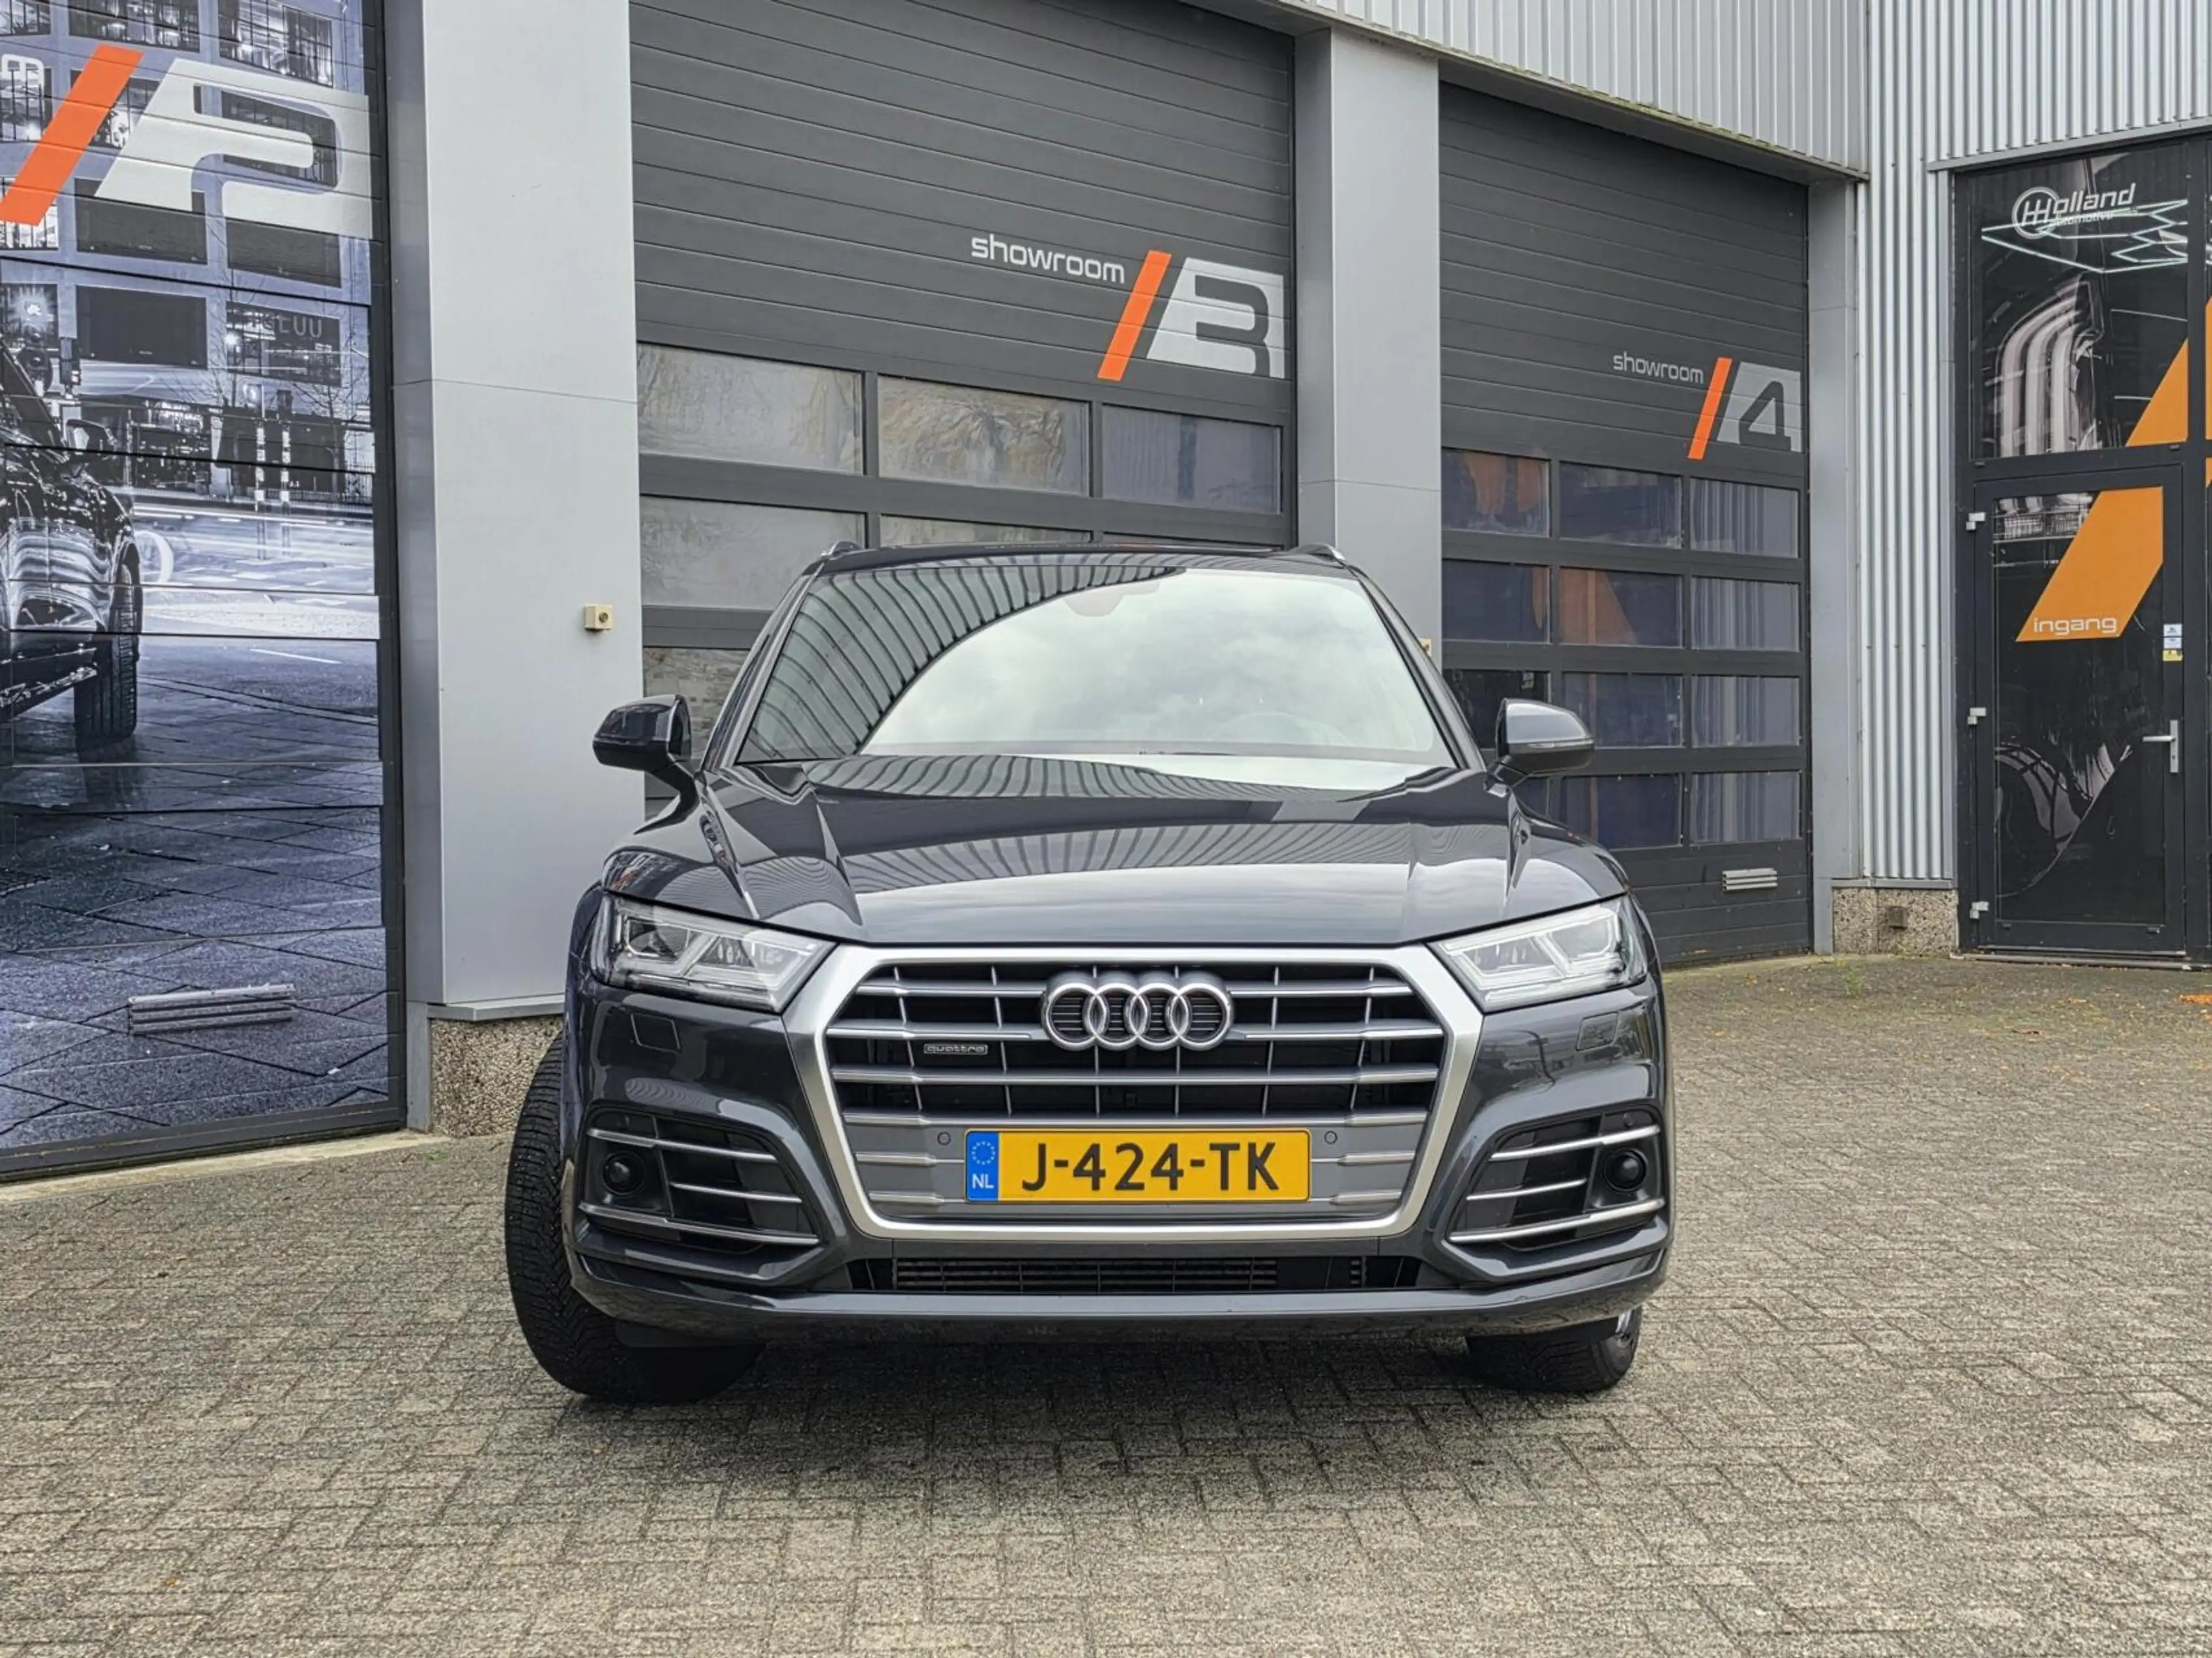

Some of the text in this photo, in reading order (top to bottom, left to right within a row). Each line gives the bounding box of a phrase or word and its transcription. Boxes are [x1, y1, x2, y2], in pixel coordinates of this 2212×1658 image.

[971, 234, 1125, 283] showroom
[1613, 351, 1703, 384] showroom
[2034, 617, 2118, 636] ingang
[927, 1045, 985, 1054] quattro
[1021, 1142, 1279, 1192] J-424-TK
[972, 1173, 994, 1189] NL
